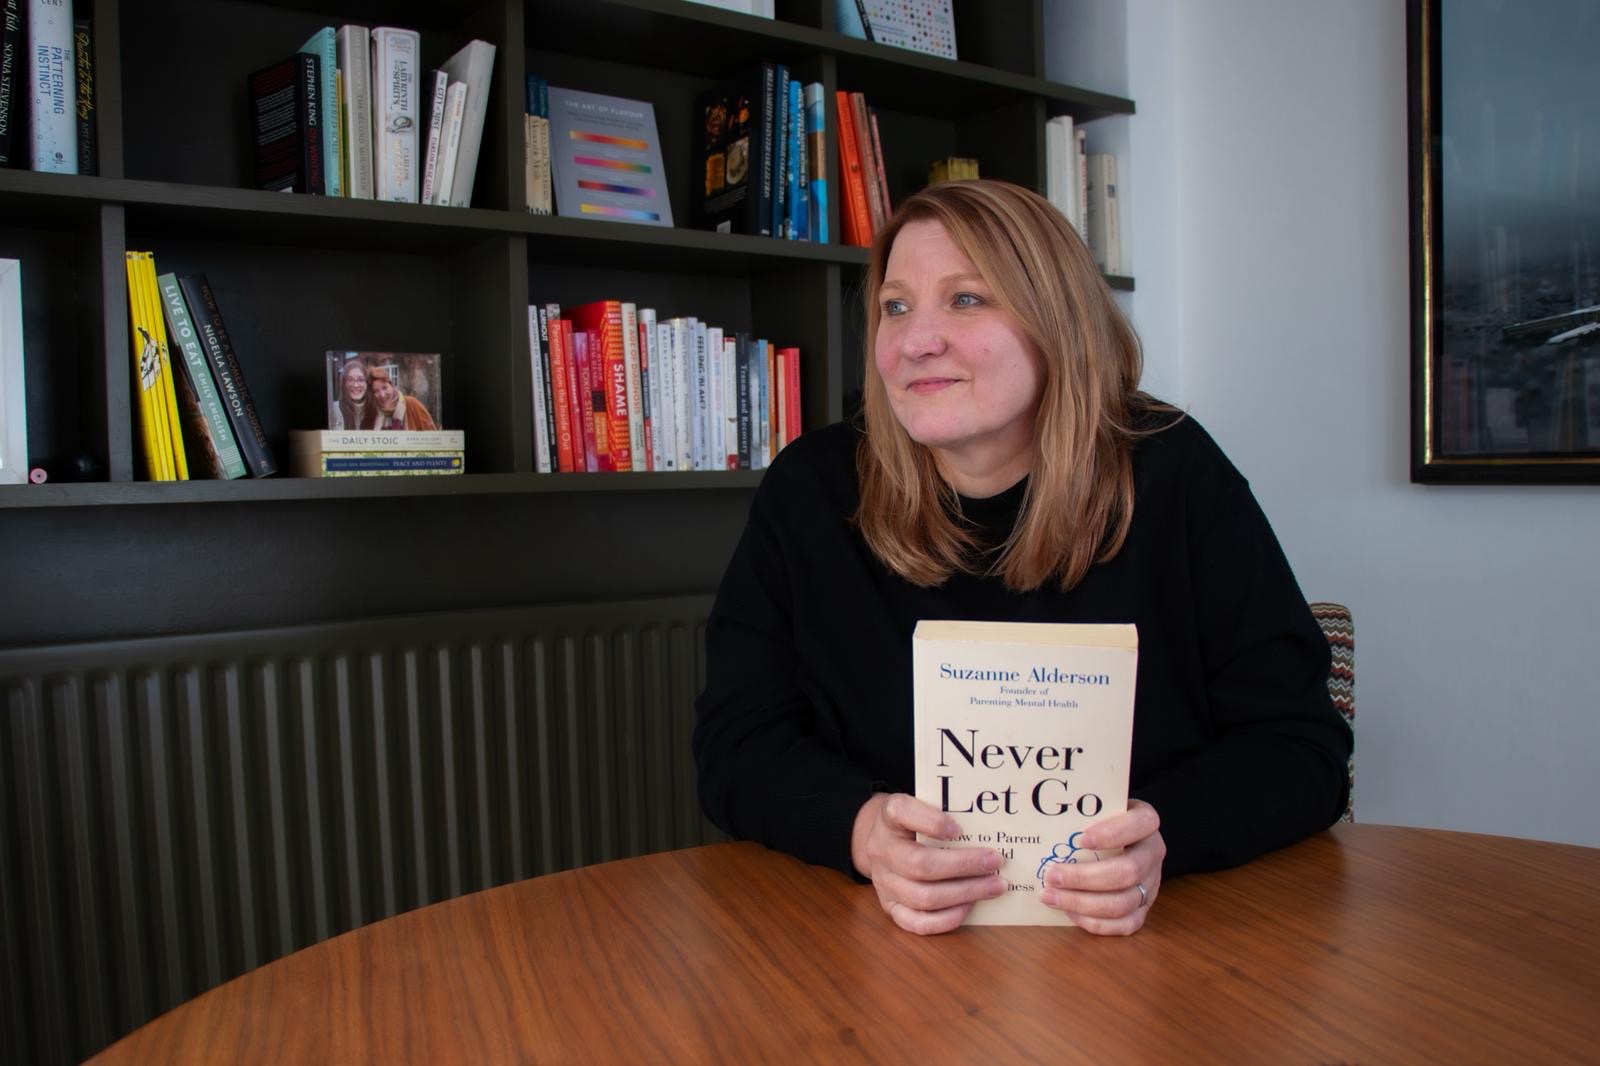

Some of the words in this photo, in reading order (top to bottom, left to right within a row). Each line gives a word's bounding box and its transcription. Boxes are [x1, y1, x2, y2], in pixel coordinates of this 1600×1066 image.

[2, 42, 14, 74] SONIA
[37, 45, 52, 96] INSTINCT
[51, 46, 65, 115] PATTERNING
[305, 57, 317, 101] STEPHEN
[307, 101, 318, 128] KING
[165, 284, 184, 316] LIVE
[177, 317, 192, 339] TO
[186, 340, 201, 367] EAT
[551, 323, 562, 366] Parenting
[697, 335, 705, 375] FEELING
[202, 284, 215, 309] HOW
[212, 311, 222, 326] TO
[226, 353, 249, 400] DOMESTIC
[245, 401, 267, 450] GODDESS
[203, 323, 225, 369] NIGELLA
[221, 371, 245, 418] LAWSON
[555, 366, 565, 388] from
[582, 367, 591, 398] TOXIC
[740, 364, 748, 396] Trauma
[558, 388, 567, 403] the
[613, 363, 628, 416] SHAME
[197, 372, 213, 401] EMILY
[206, 401, 228, 442] ENGLISH
[560, 404, 569, 431] Inside
[585, 399, 594, 434] STRESS
[342, 436, 368, 446] DAILY
[371, 436, 399, 445] STOIC
[562, 432, 571, 451] Out
[741, 415, 749, 455] Recovery
[940, 663, 1020, 682] Suzanne
[1027, 667, 1110, 685] Alderson
[970, 697, 1012, 708] Parenting
[1015, 698, 1045, 708] Mental
[1048, 699, 1079, 709] Health
[1000, 686, 1036, 696] Founder
[1039, 686, 1049, 696] of
[937, 728, 1083, 771] Never
[937, 775, 1018, 815] Let
[1031, 778, 1103, 817] Go
[978, 833, 991, 843] to
[996, 831, 1041, 844] Parent
[1007, 882, 1035, 892] ness
